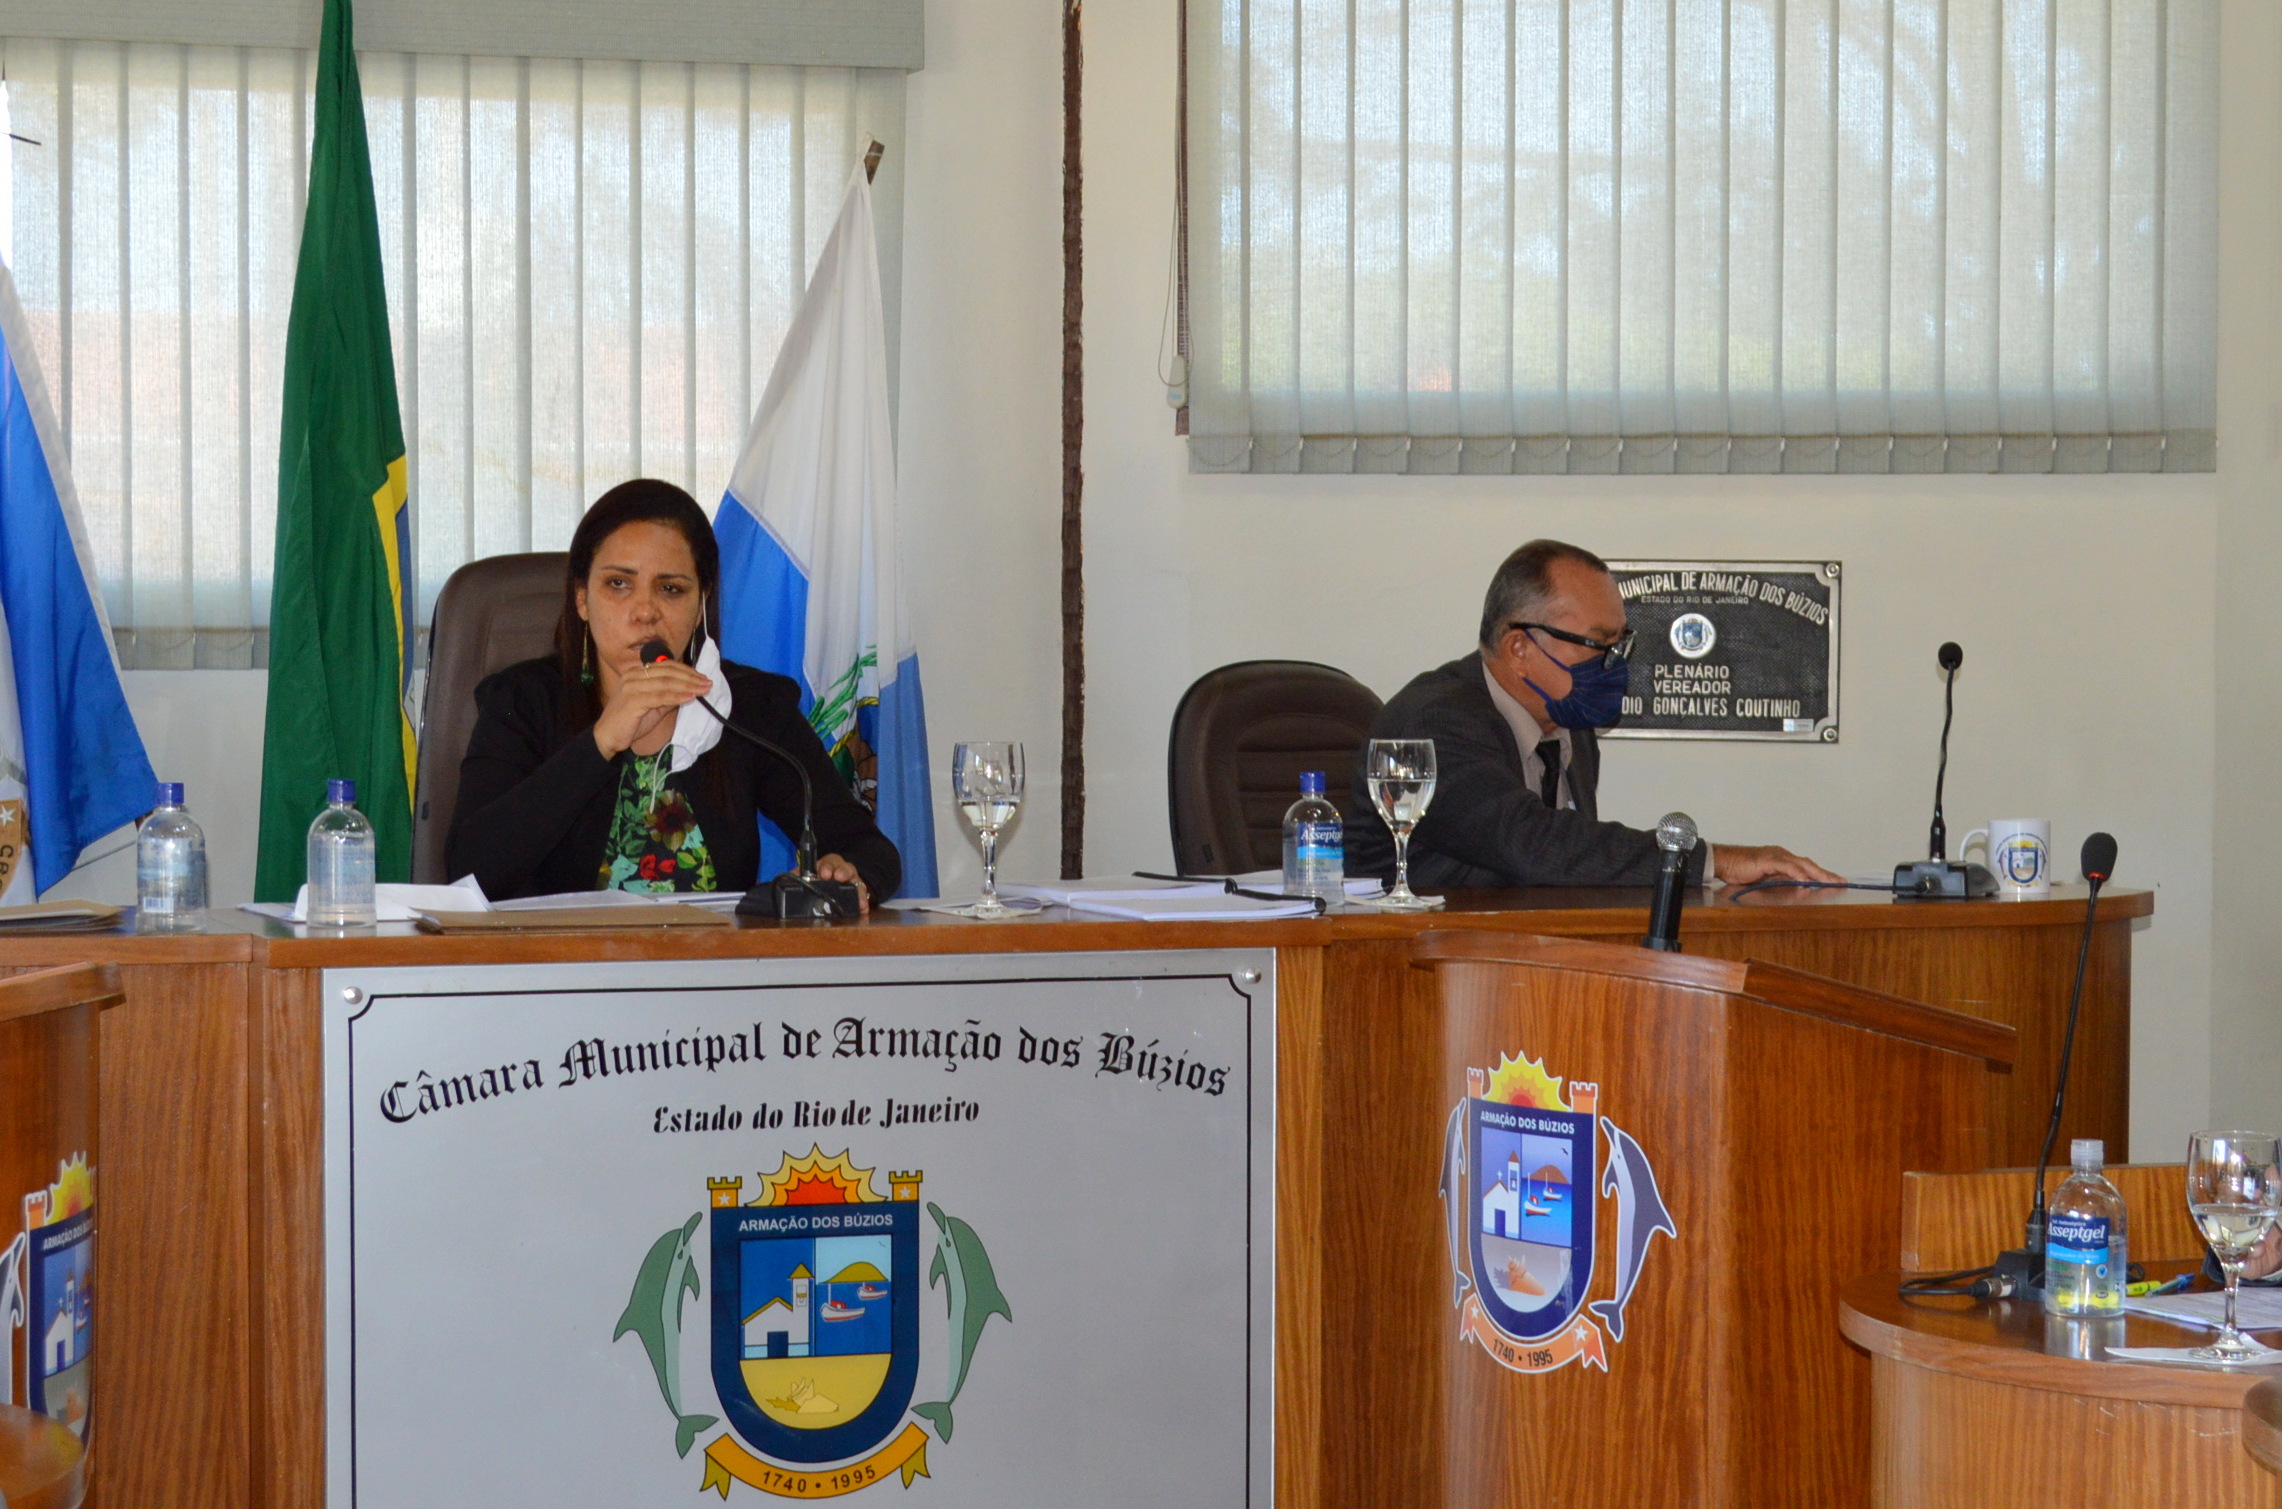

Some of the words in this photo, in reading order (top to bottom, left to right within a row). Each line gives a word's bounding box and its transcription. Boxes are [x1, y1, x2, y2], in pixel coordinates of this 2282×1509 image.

[1641, 595, 1671, 604] ESTADO
[1673, 595, 1685, 604] DO
[1686, 595, 1700, 604] RIO
[1702, 595, 1713, 604] DE
[1715, 595, 1749, 605] JANEIRO
[1681, 571, 1697, 591] DE
[1700, 571, 1758, 598] ARMAÇÃO
[1759, 581, 1786, 606] DOS
[1784, 591, 1829, 626] BÚZIOS
[1654, 662, 1730, 679] PLENÁRIO
[1653, 680, 1731, 695] VEREADOR
[1621, 696, 1643, 715] DIO
[1653, 697, 1728, 718] GONÇALVES
[1736, 698, 1801, 718] COUTINHO
[379, 1060, 545, 1124] Câmara
[558, 1021, 767, 1089] Municipal
[781, 1020, 822, 1060] de
[832, 1016, 1001, 1073] Armação
[1018, 1026, 1084, 1068] dos
[1095, 1032, 1231, 1097] Búzios
[653, 1104, 743, 1134] Estado
[752, 1102, 784, 1130] do
[792, 1100, 836, 1128] Rio
[840, 1099, 872, 1126] de
[879, 1096, 980, 1129] Janeiro
[1480, 1110, 1516, 1128] ARMAÇÃO
[1518, 1116, 1537, 1130] DOS
[1538, 1117, 1575, 1134] BÚZIOS
[738, 1215, 808, 1232] ARMAÇÃO
[812, 1215, 841, 1229] DOS
[843, 1212, 894, 1227] BÚZIOS
[1493, 1339, 1515, 1363] 1740
[1527, 1349, 1553, 1367] 1995
[763, 1470, 807, 1492] 1740
[831, 1465, 876, 1490] 1995
